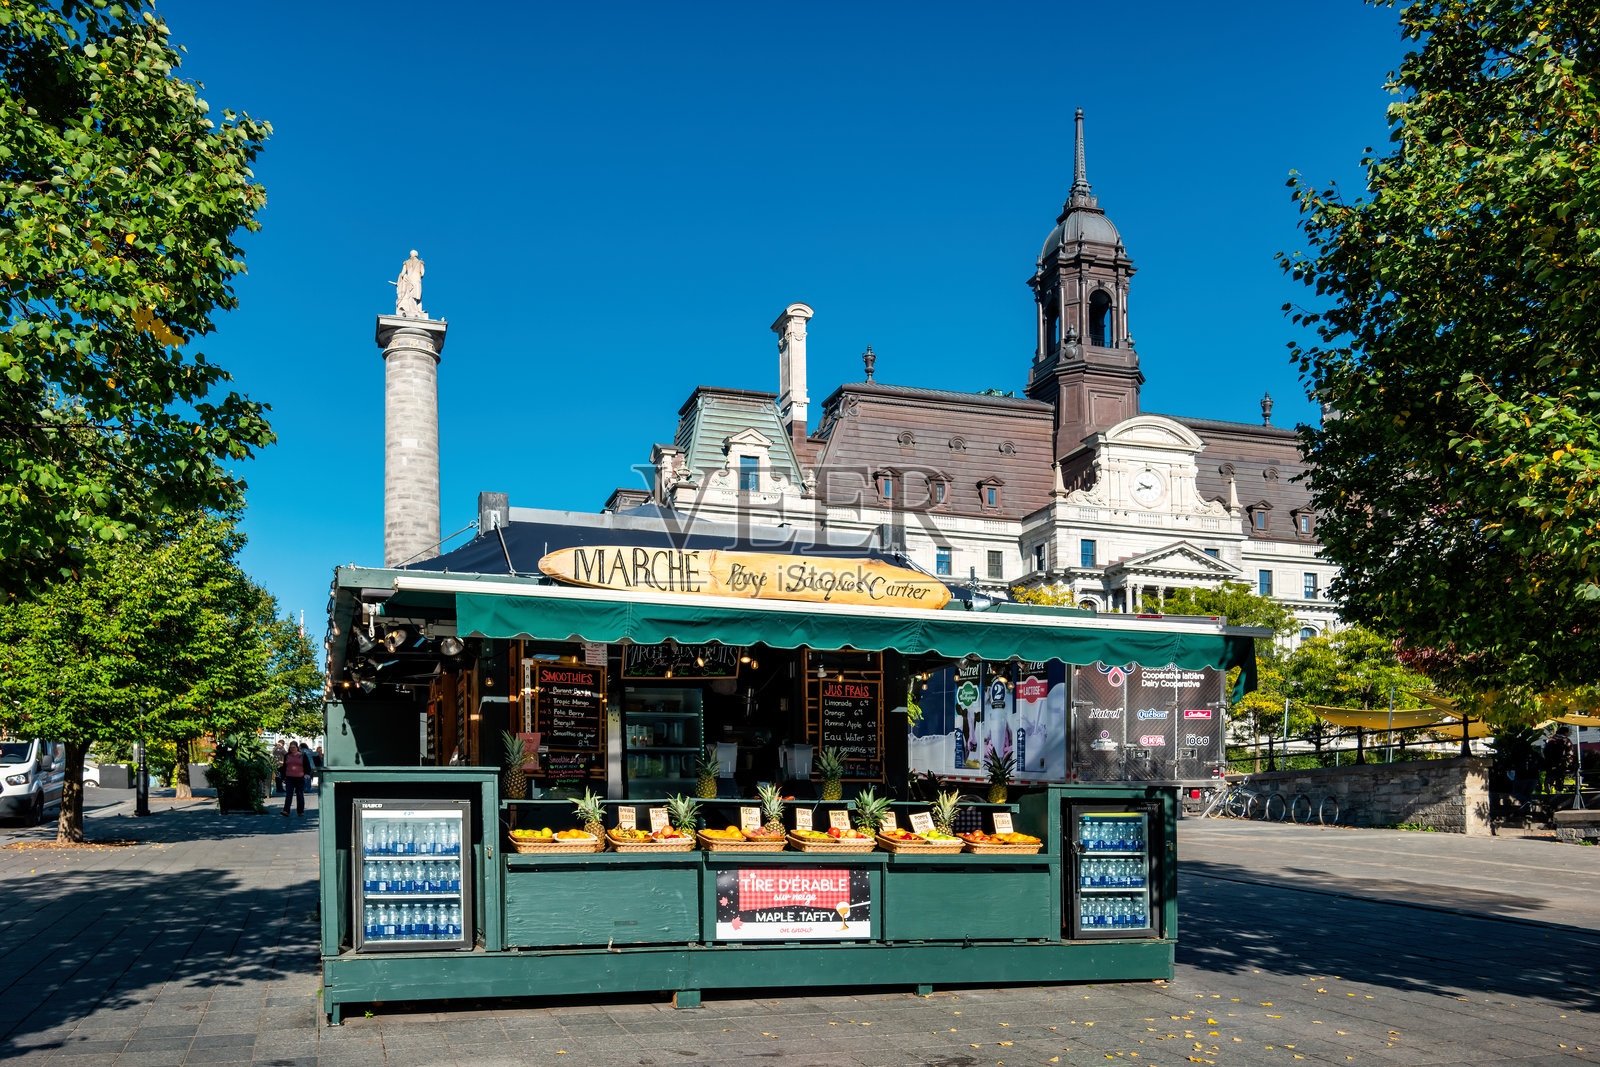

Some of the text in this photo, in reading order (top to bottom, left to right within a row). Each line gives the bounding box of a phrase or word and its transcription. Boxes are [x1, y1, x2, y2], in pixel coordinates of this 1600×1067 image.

[573, 547, 930, 601] MARCHÉ Place Jacques Cartier
[1141, 680, 1201, 688] Dairy Cooperative
[824, 731, 842, 741] Eau
[1140, 735, 1165, 746] OKA
[741, 872, 847, 891] TIRE D'ÉRABLE
[792, 892, 816, 905] neige
[756, 912, 835, 922] MAPLE TAFFY
